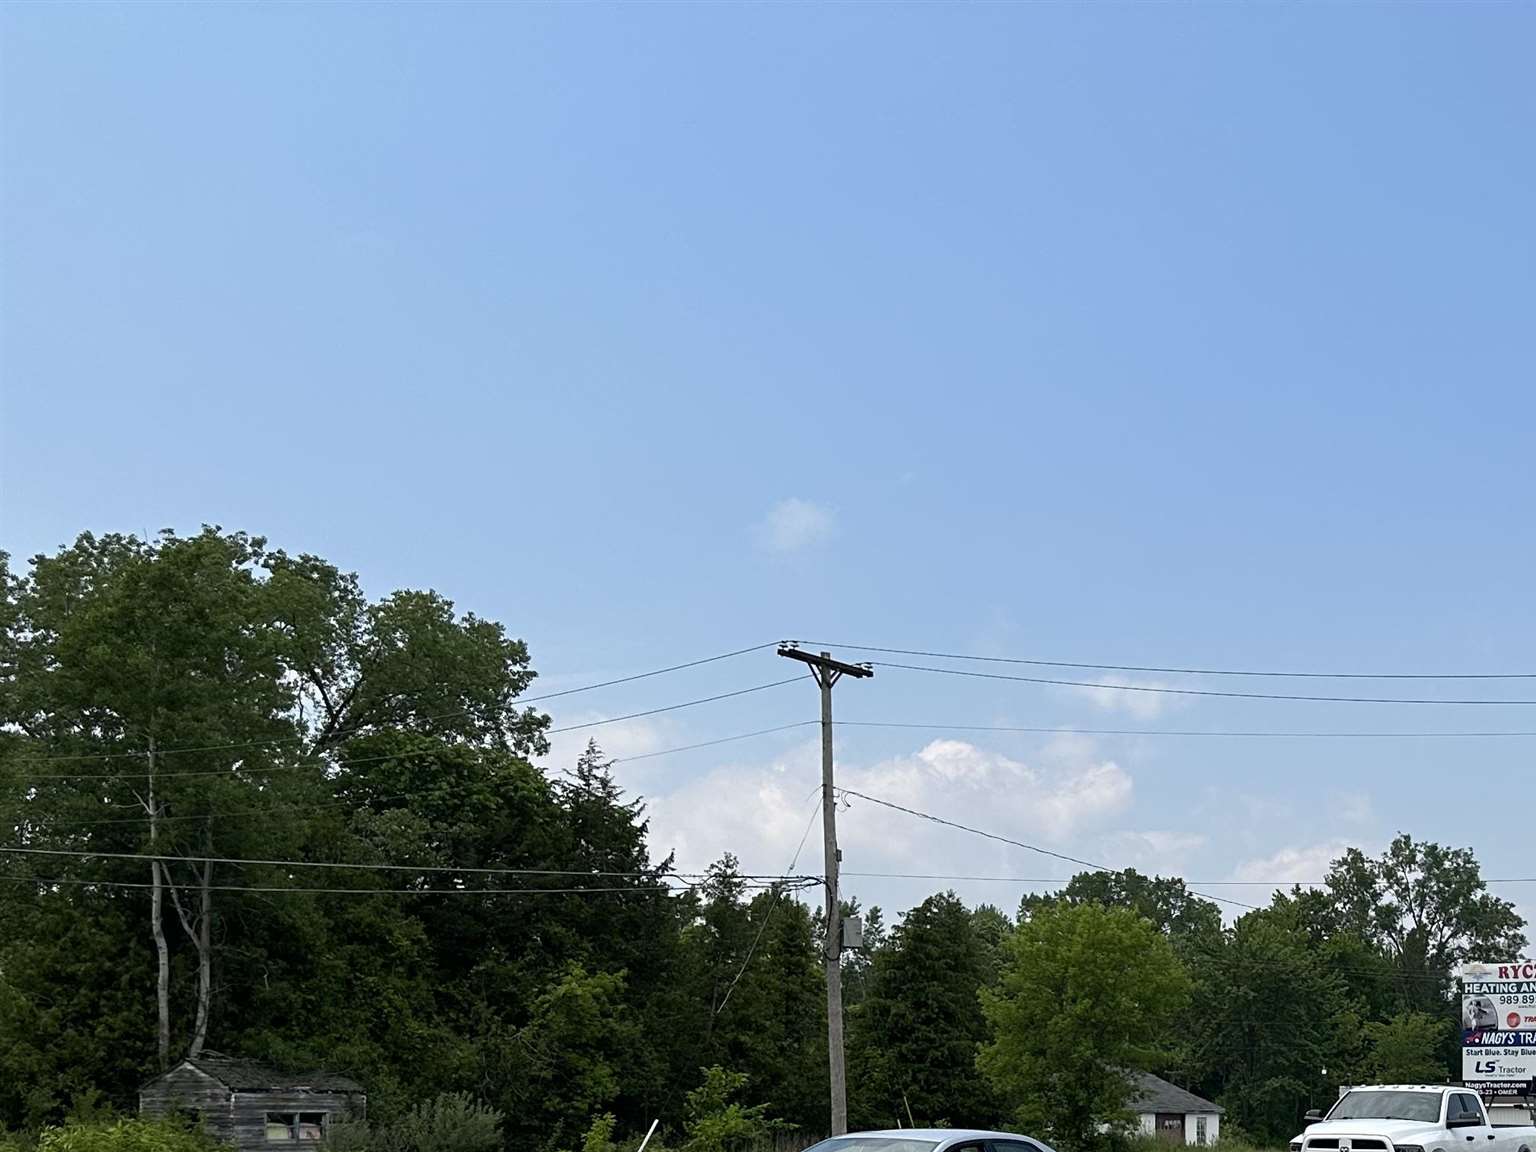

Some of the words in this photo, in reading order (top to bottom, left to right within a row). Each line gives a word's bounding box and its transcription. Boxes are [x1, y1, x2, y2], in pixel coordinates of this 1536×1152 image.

[1464, 983, 1517, 994] HEATING
[1466, 1048, 1483, 1056] Start
[1484, 1048, 1502, 1056] Blue.
[1503, 1048, 1519, 1057] Stay
[1475, 1061, 1496, 1073] LS
